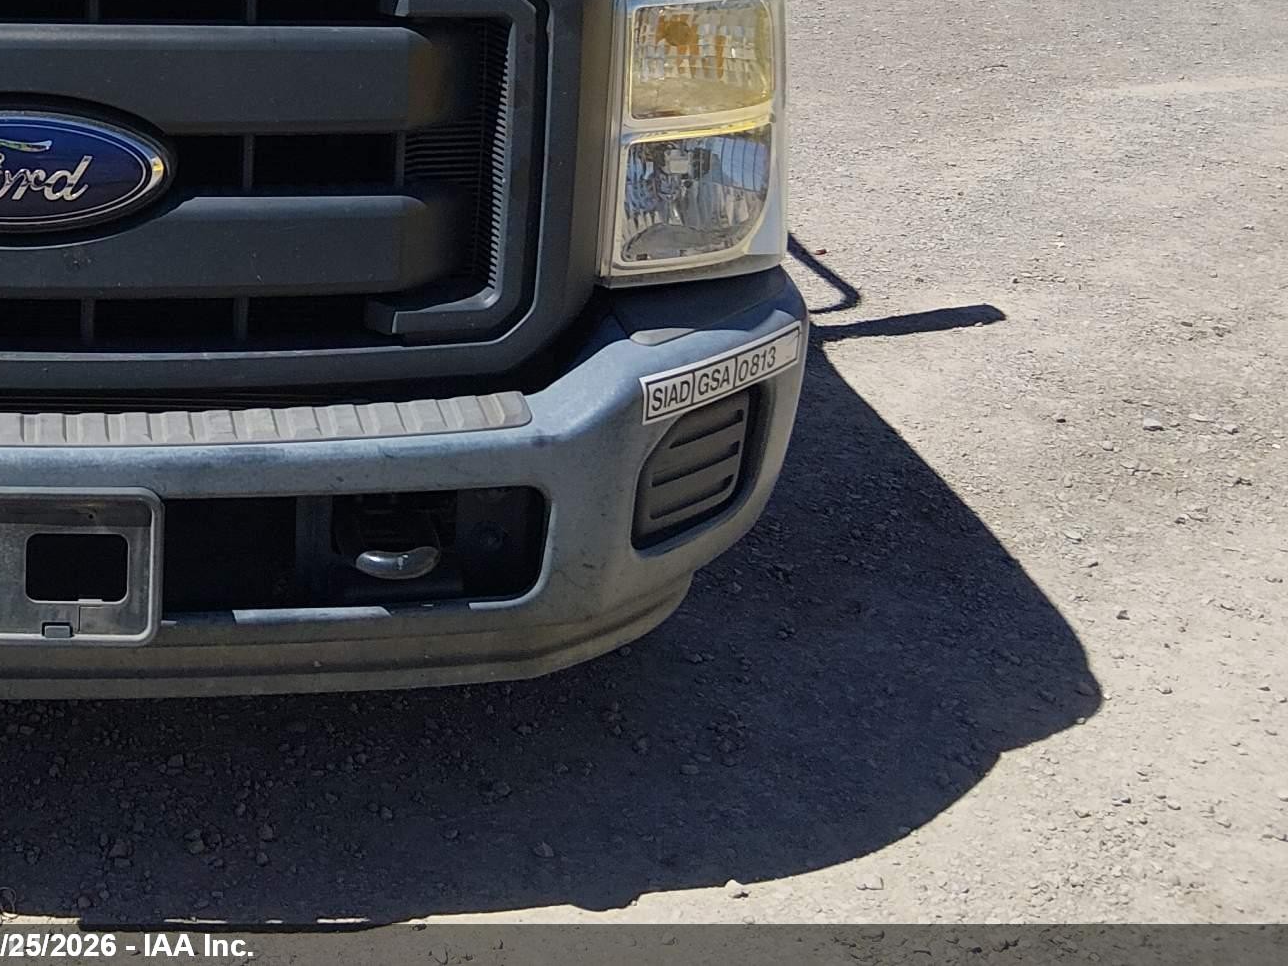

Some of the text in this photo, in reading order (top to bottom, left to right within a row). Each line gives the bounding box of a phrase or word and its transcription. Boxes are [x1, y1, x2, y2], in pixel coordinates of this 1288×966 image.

[651, 346, 777, 412] SIAD GSA 0813
